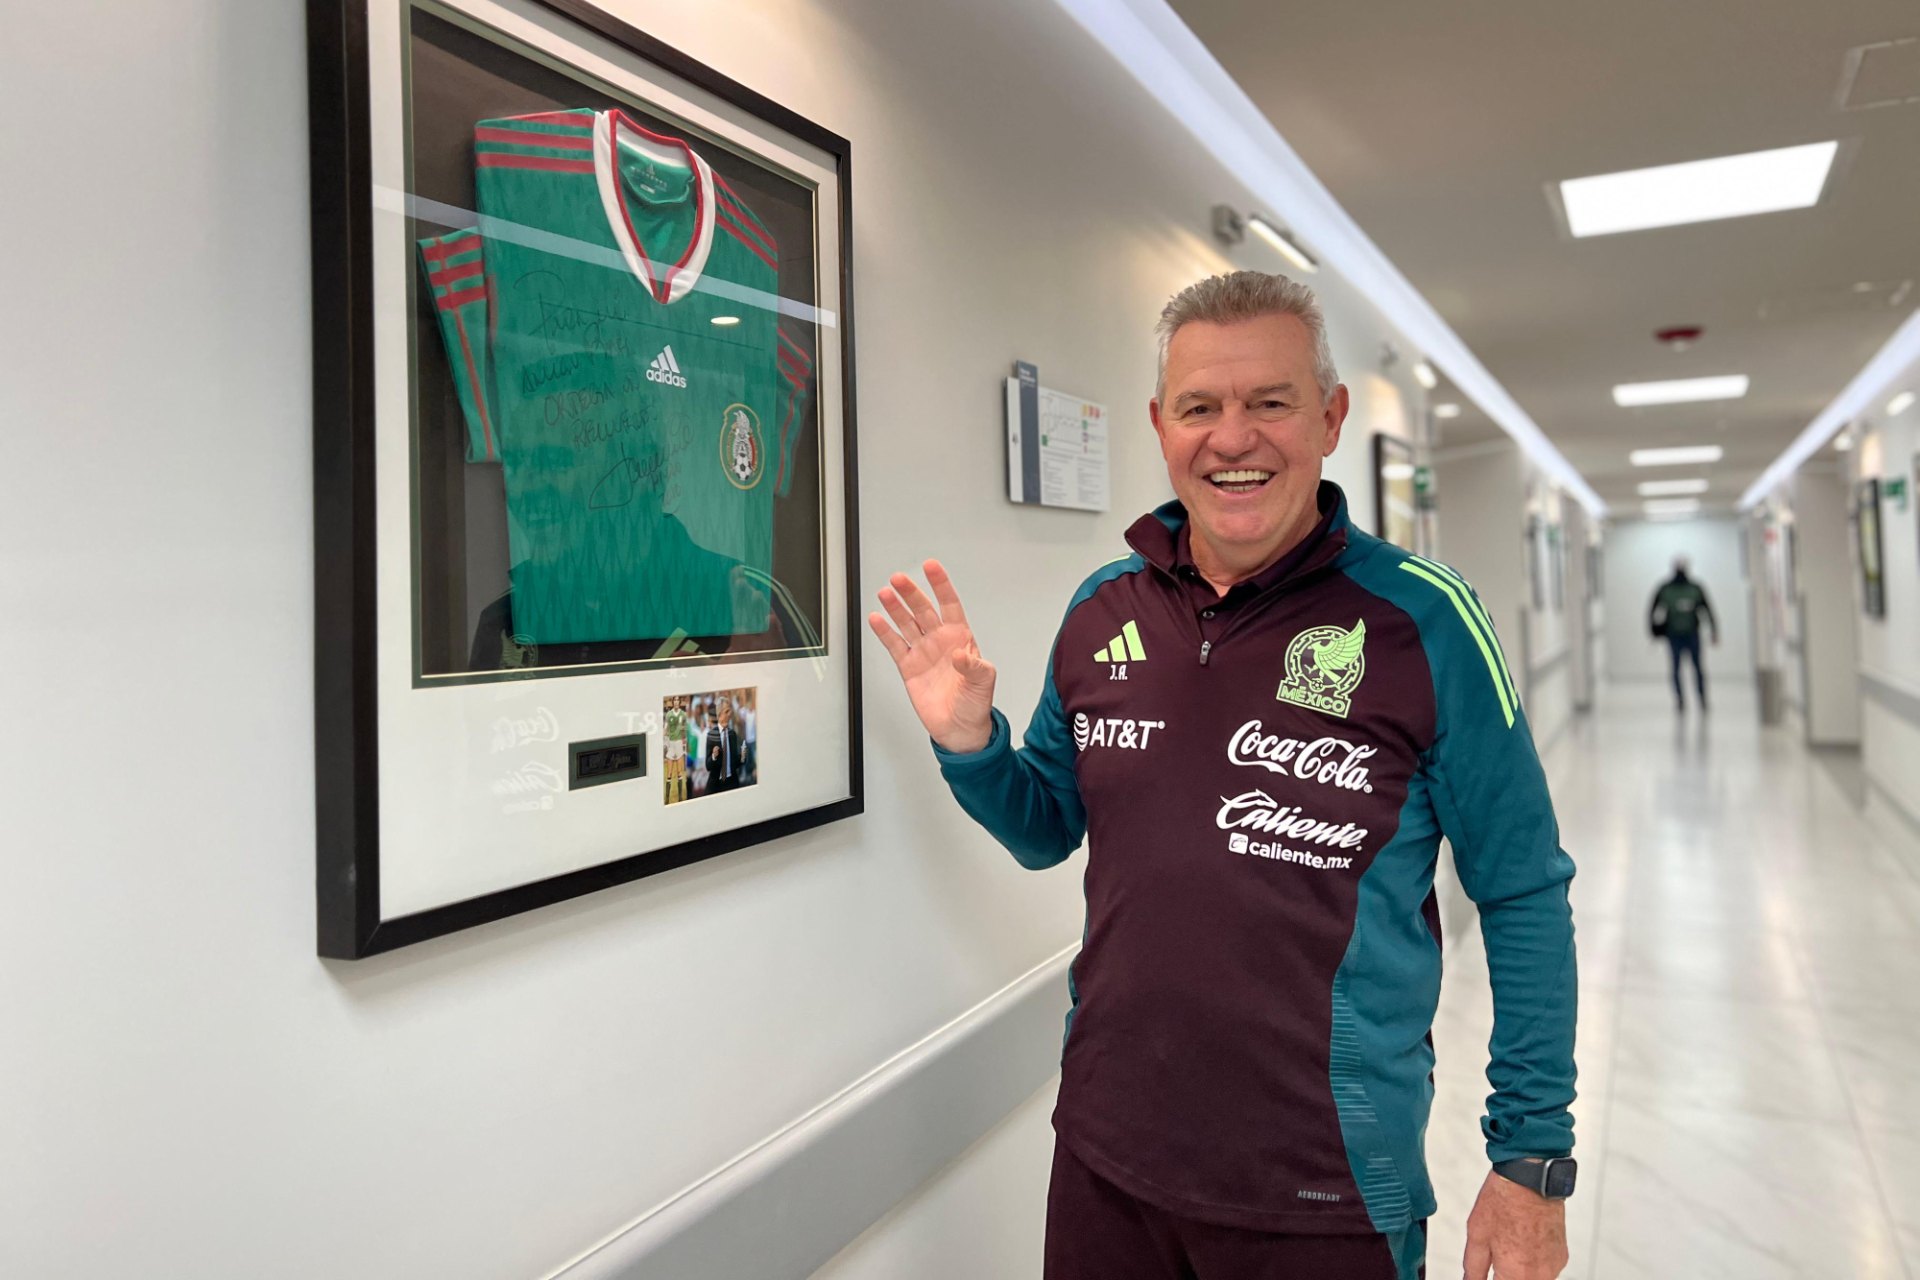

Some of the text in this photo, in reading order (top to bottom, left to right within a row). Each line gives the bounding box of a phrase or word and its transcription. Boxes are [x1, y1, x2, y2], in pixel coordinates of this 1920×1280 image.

[646, 368, 687, 389] adidas
[1109, 664, 1128, 680] J.A.
[1089, 718, 1158, 750] AT&T
[1227, 719, 1378, 791] Coca-Cola
[1216, 788, 1369, 849] Caliente
[1249, 841, 1353, 870] caliente.mx
